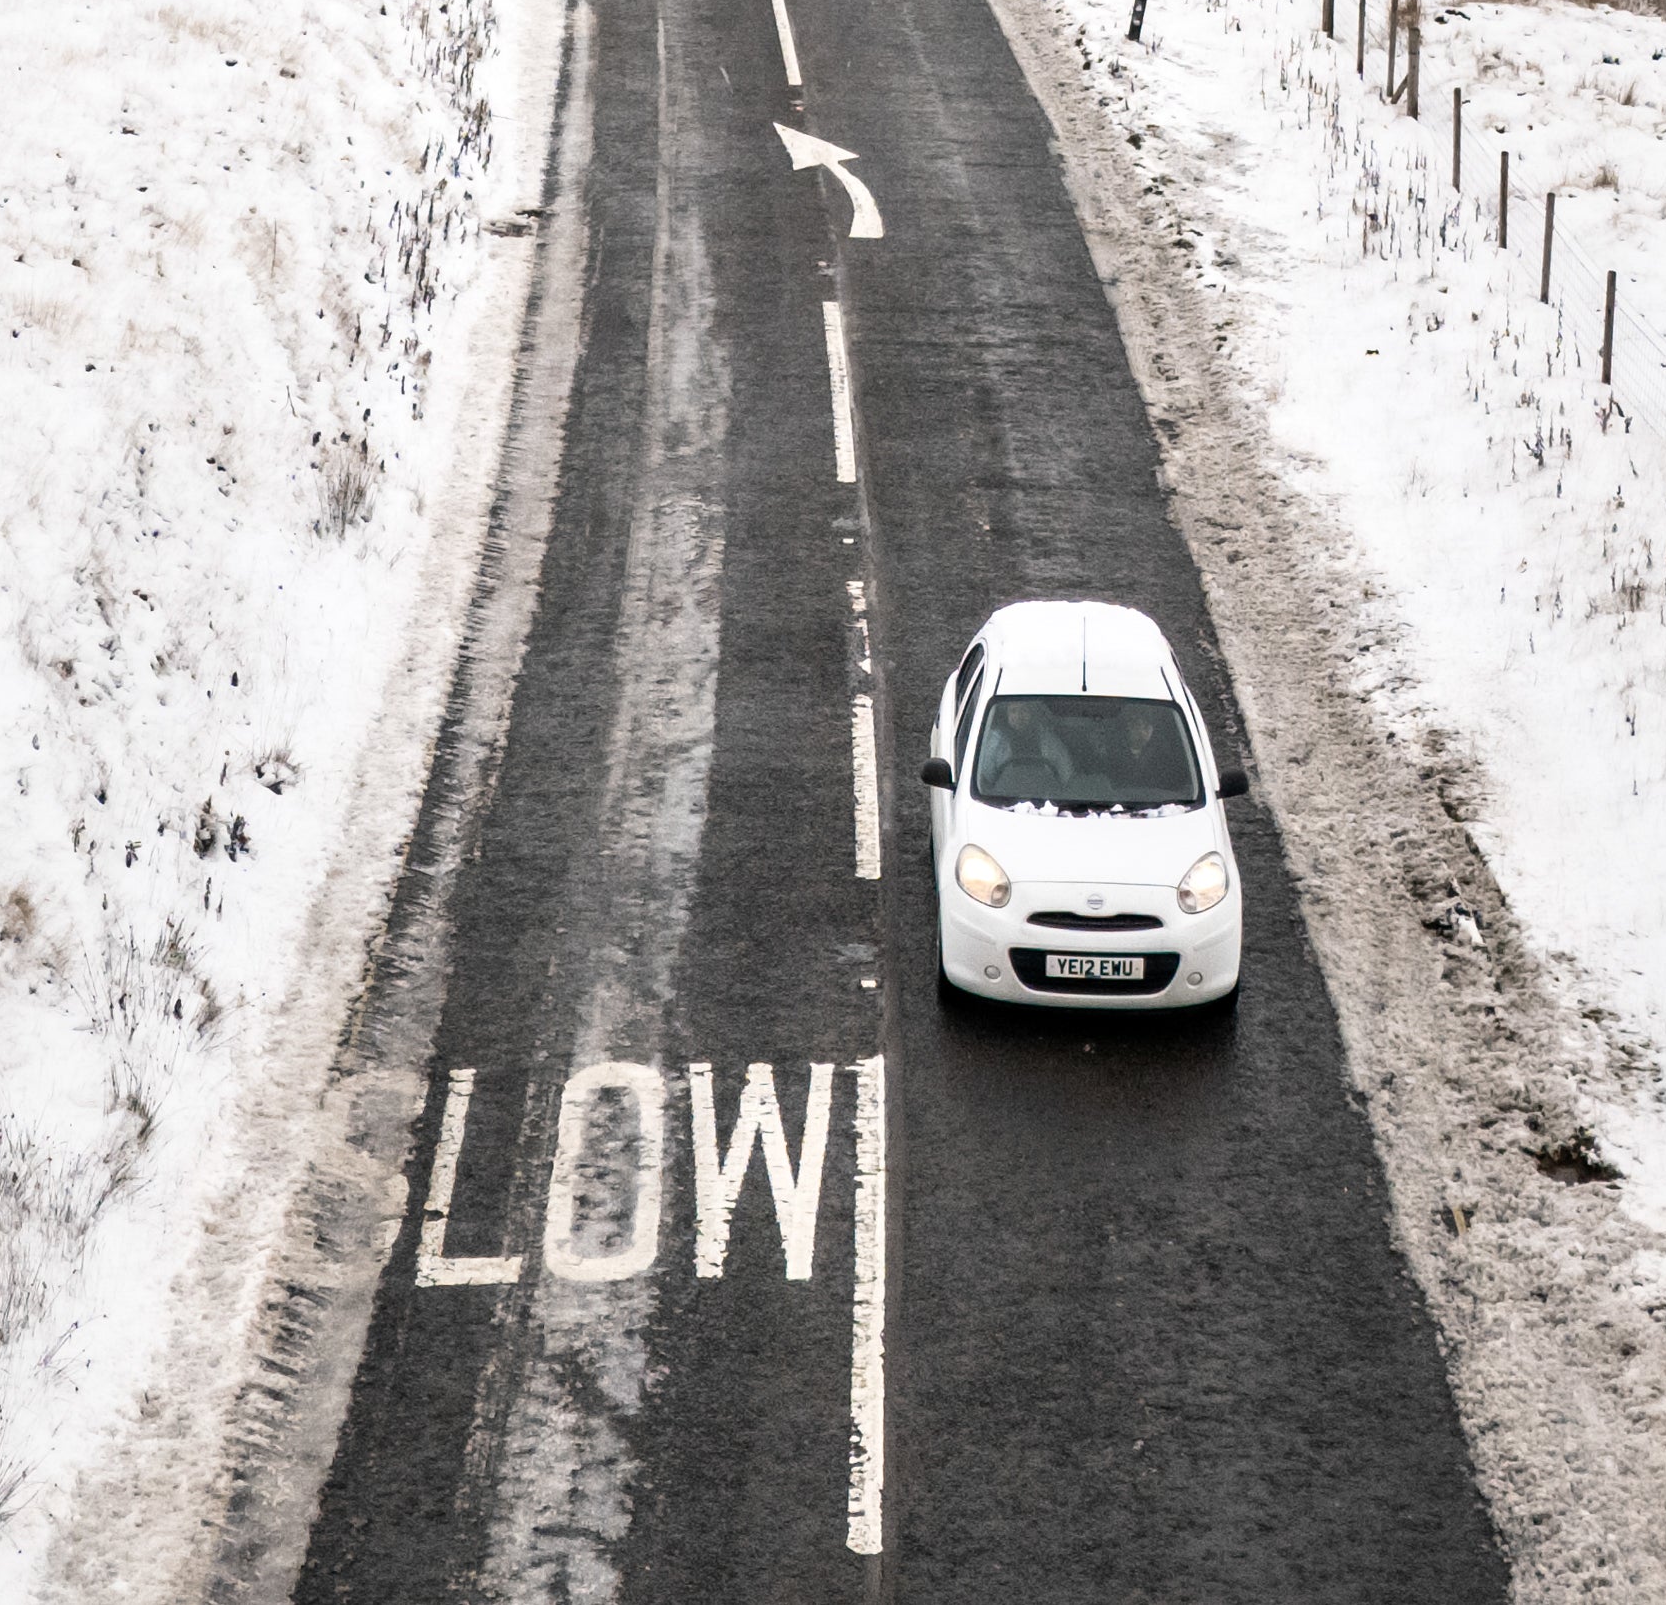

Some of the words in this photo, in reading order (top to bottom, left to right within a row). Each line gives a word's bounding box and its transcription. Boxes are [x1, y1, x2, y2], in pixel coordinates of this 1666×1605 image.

[1057, 958, 1095, 976] YE12
[1100, 960, 1133, 976] EWU
[353, 1061, 835, 1287] LOW
